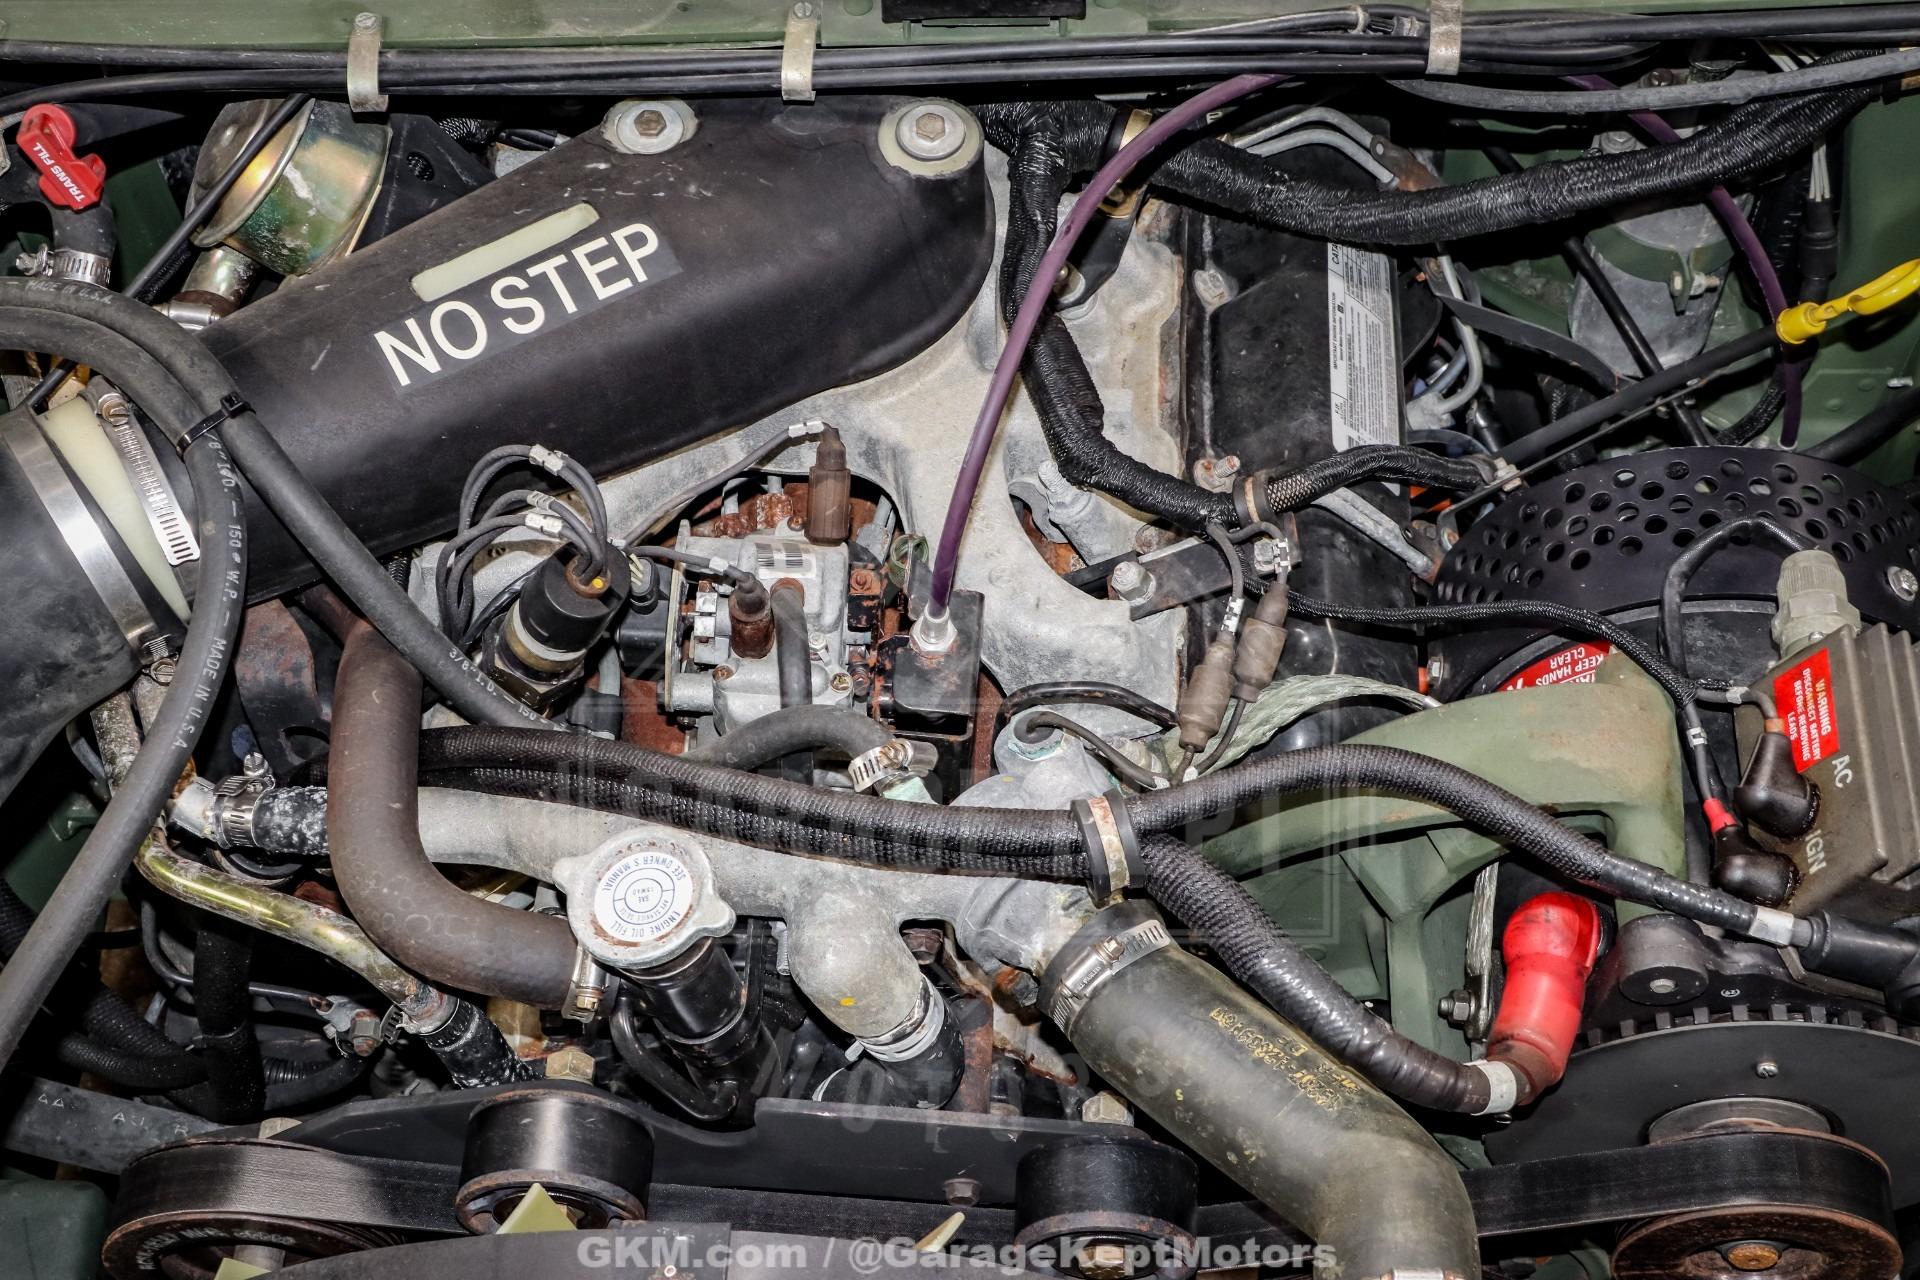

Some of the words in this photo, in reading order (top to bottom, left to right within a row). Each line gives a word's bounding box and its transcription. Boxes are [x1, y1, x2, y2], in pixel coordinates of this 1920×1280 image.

[32, 142, 55, 166] FILL
[51, 165, 86, 202] TRANS
[374, 301, 488, 386] NO
[490, 223, 659, 334] STEP
[228, 523, 242, 548] 150
[222, 569, 241, 602] W.P.
[202, 636, 227, 681] MADE
[1550, 646, 1586, 670] CLEAR
[1574, 653, 1604, 673] KEEP
[1535, 664, 1573, 687] HANDS
[193, 683, 212, 702] IN
[1793, 680, 1805, 714] BEFORE
[1802, 667, 1817, 722] DISCONNECT
[1815, 678, 1832, 736] WARNING
[171, 705, 203, 750] U.S.A.
[1787, 711, 1799, 740] LEADS
[1798, 713, 1812, 761] REMOVING
[1809, 722, 1822, 760] BATTERY
[1832, 754, 1853, 789] AC
[1804, 828, 1828, 875] IGN
[602, 862, 631, 892] MANUAL
[672, 865, 687, 881] SEE
[610, 919, 627, 937] FILL
[631, 928, 645, 938] OIL
[650, 909, 681, 936] ENGINE
